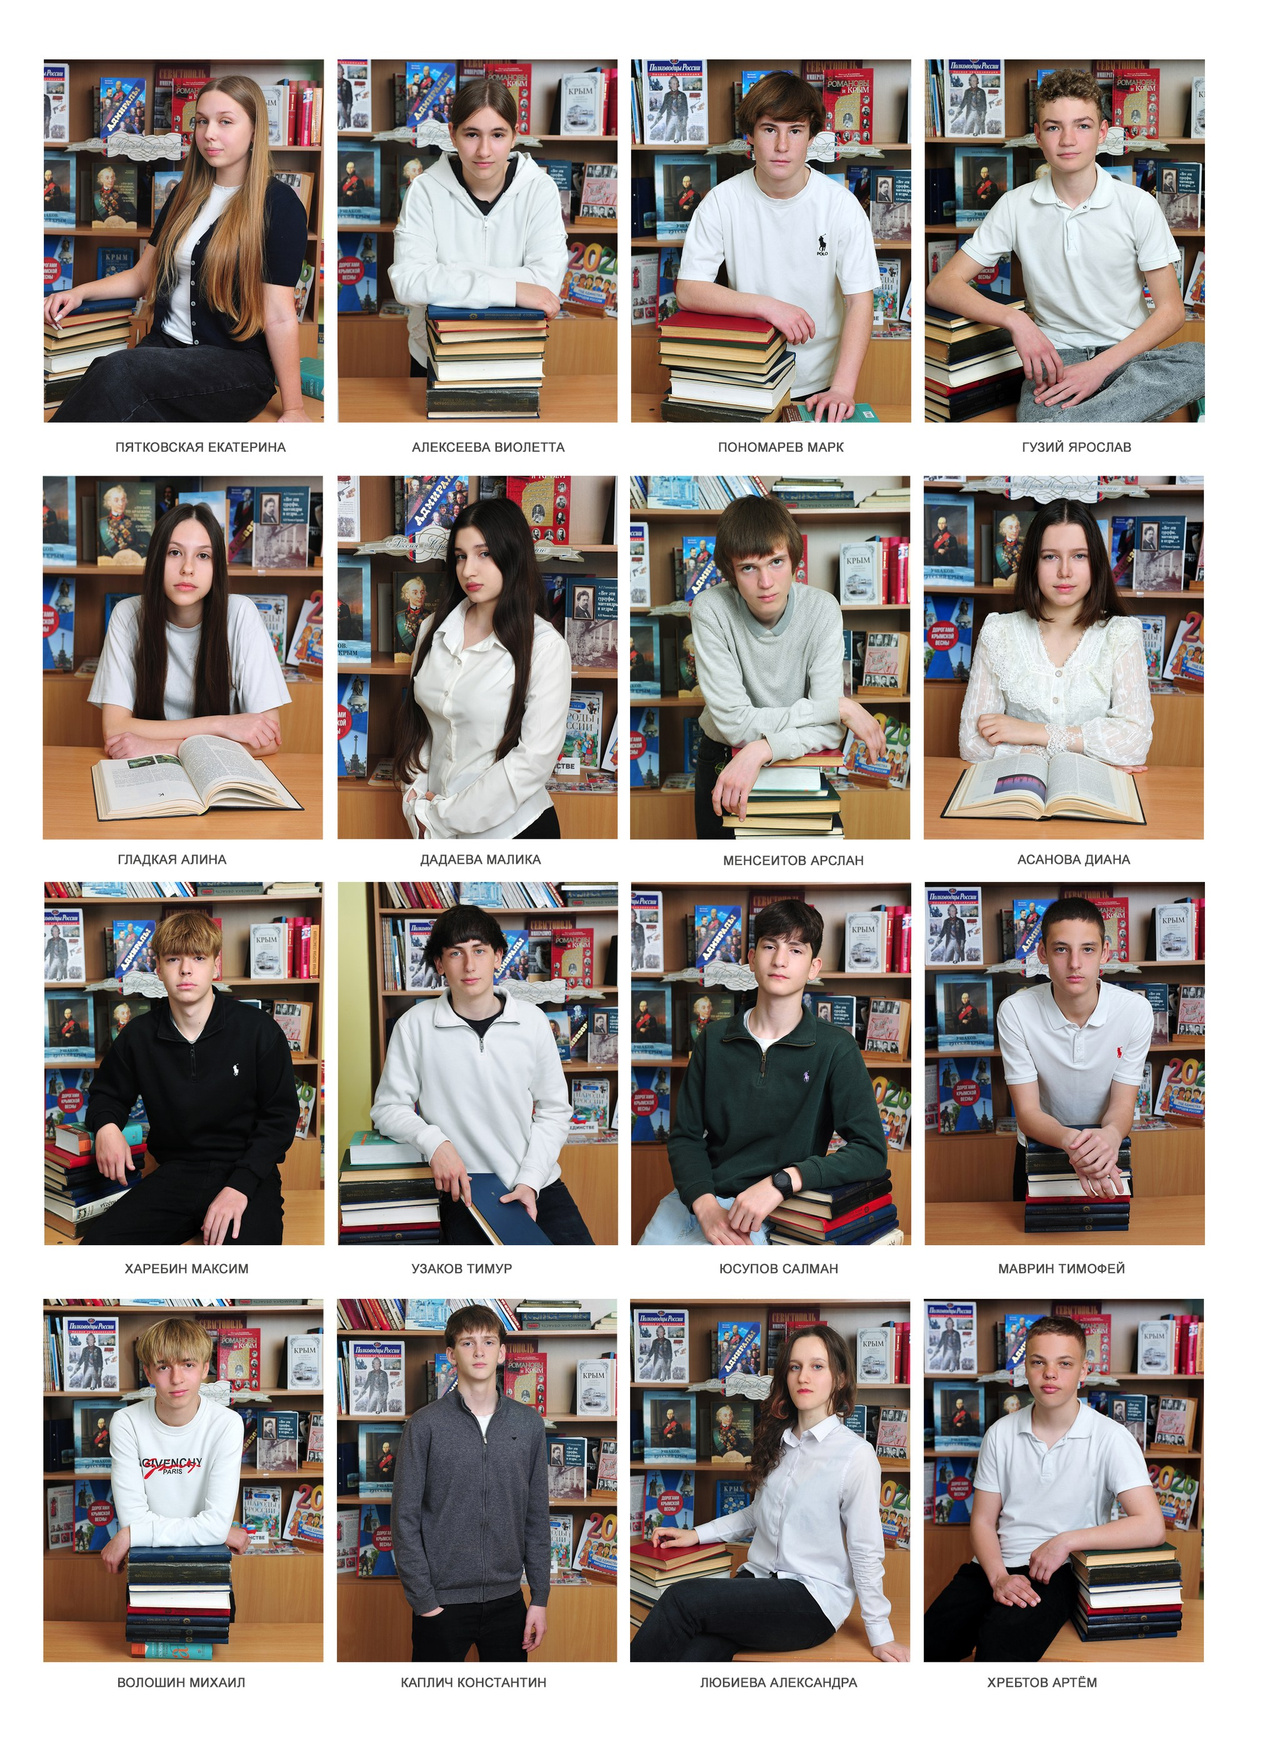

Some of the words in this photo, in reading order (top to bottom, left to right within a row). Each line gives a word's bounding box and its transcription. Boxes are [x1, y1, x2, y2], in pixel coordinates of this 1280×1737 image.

[568, 87, 593, 96] КРЫМ
[413, 73, 450, 121] АДМИРАЛЫ
[106, 86, 141, 131] АДМИРАЛЫ
[105, 253, 128, 261] КРЫМ
[846, 556, 871, 565] КРЫМ
[567, 712, 595, 722] РОДЫ
[566, 722, 593, 732] ССИИ
[556, 762, 575, 770] СТВЕ
[1162, 915, 1185, 924] КРЫМ
[851, 925, 875, 934] КРЫМ
[255, 936, 278, 944] КРЫМ
[701, 914, 737, 961] АДМИРАЛЫ
[120, 927, 152, 972] АДМИРАЛЫ
[569, 1124, 595, 1132] ЕДИНСТВЕ
[1144, 1332, 1165, 1340] КРЫМ
[862, 1339, 885, 1348] КРЫМ
[293, 1346, 316, 1354] КРЫМ
[582, 1372, 606, 1380] КРЫМ
[139, 1457, 203, 1468] GIVENCHY
